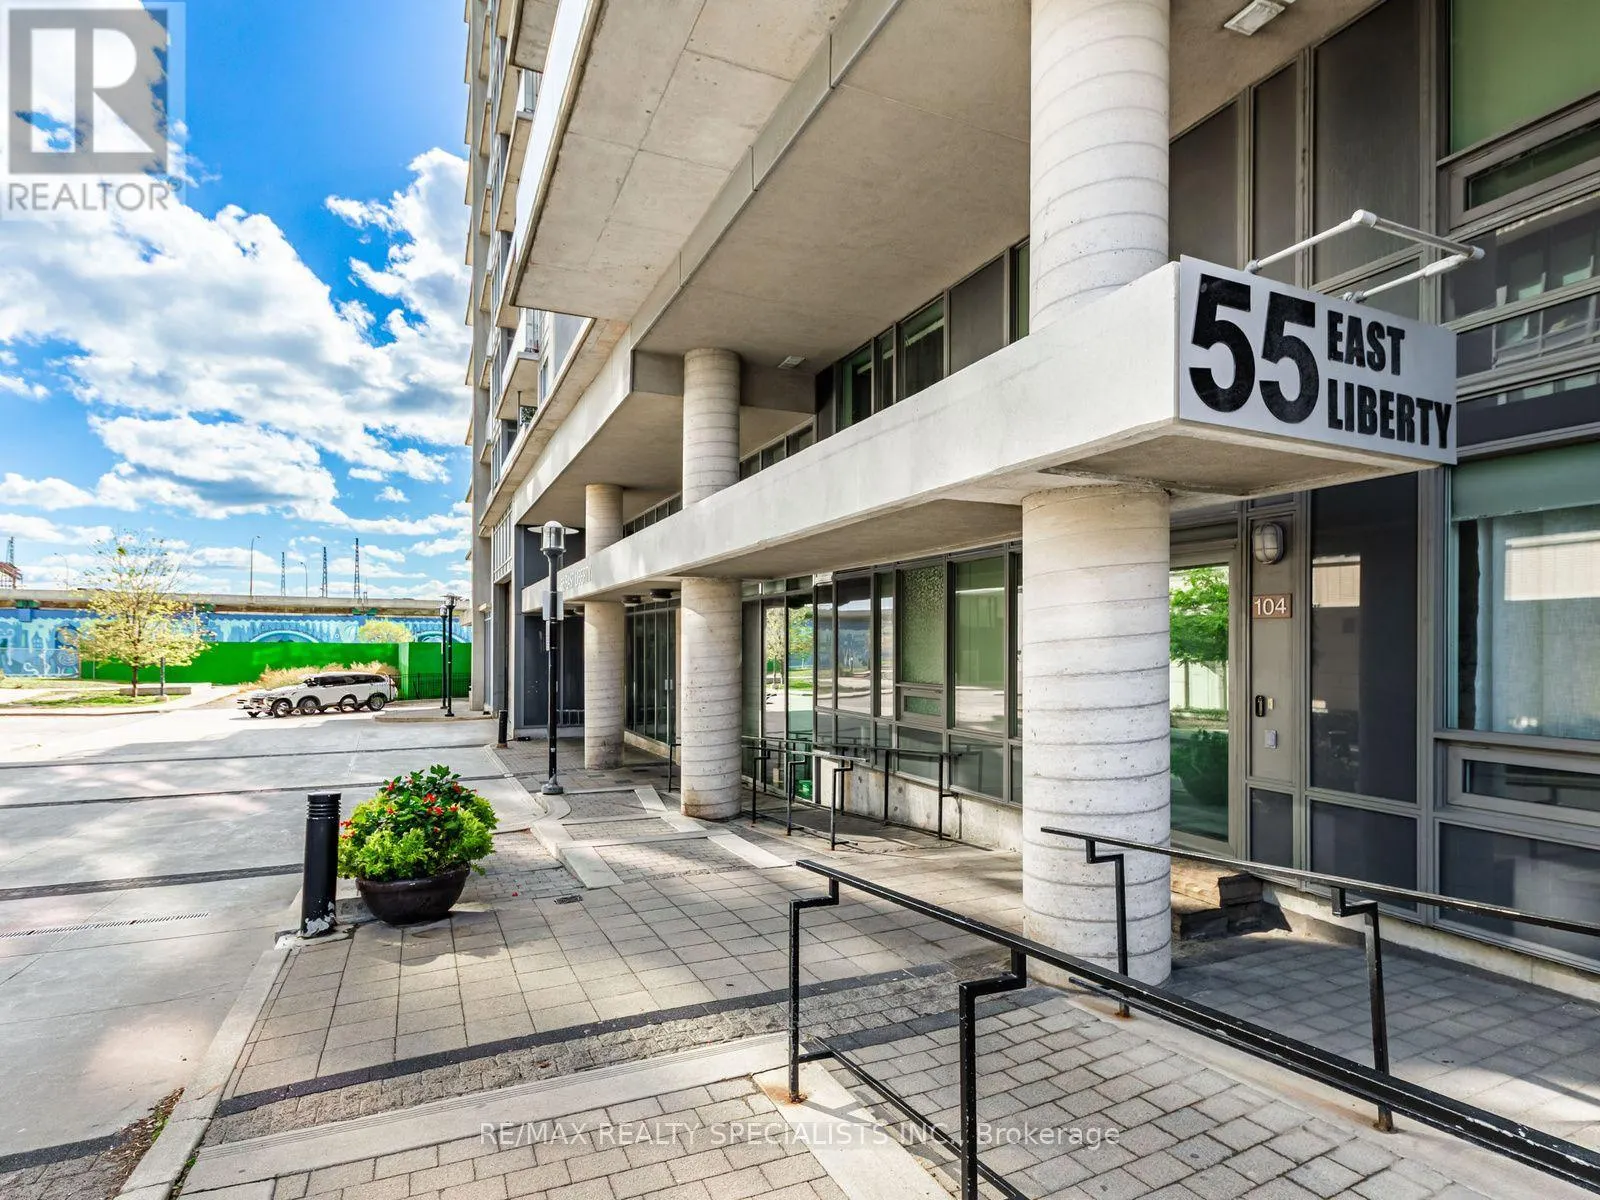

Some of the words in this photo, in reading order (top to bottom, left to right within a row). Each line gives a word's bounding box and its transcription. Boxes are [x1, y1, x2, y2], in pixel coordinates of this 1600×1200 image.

[1189, 273, 1320, 424] 55
[1327, 310, 1405, 376] EAST
[1327, 378, 1452, 449] LIBERTY
[1254, 597, 1287, 616] 104
